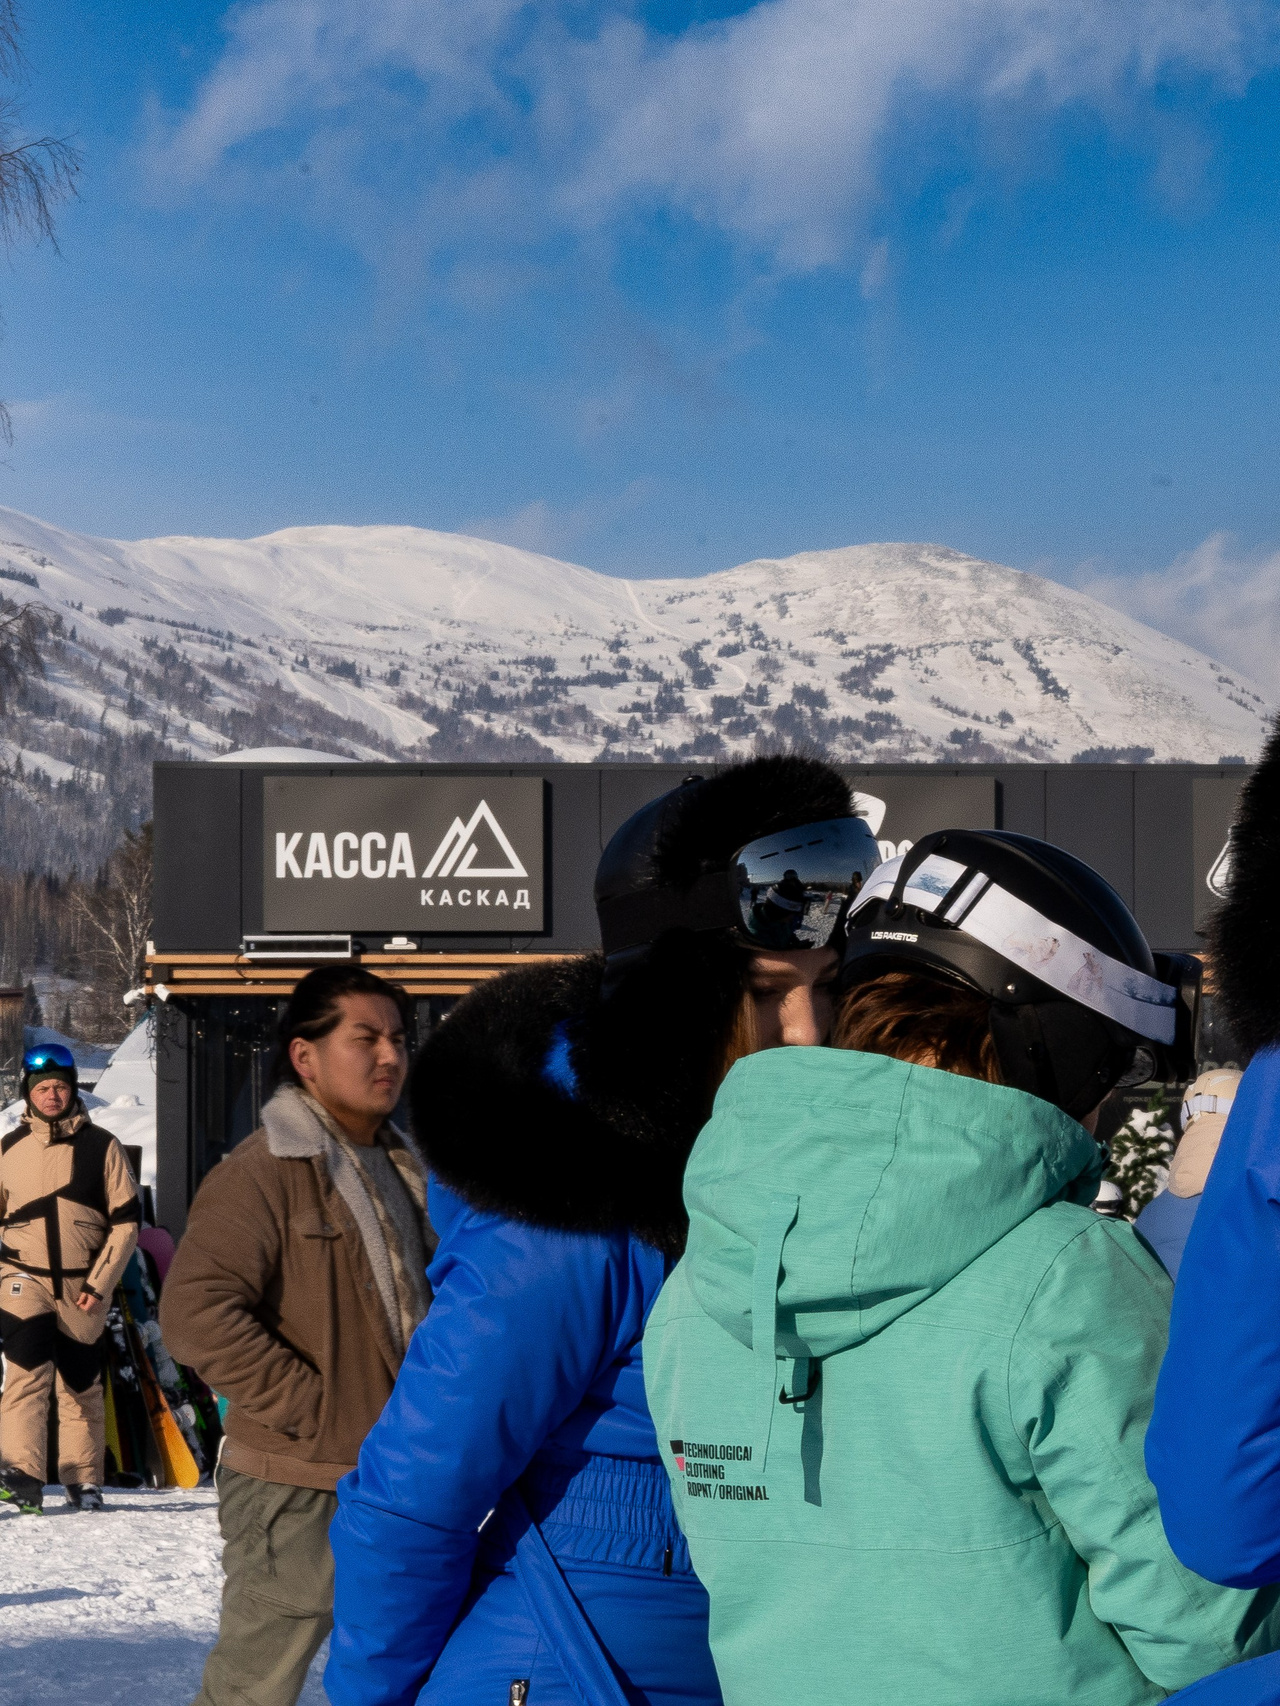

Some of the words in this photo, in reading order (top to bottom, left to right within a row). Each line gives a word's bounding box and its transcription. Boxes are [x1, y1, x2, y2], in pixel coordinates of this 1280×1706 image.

[275, 832, 416, 878] КАССА
[420, 889, 531, 909] КАСКАД
[871, 931, 884, 940] LOS
[883, 931, 918, 943] RAKETOS
[685, 1462, 725, 1480] CLOTHING
